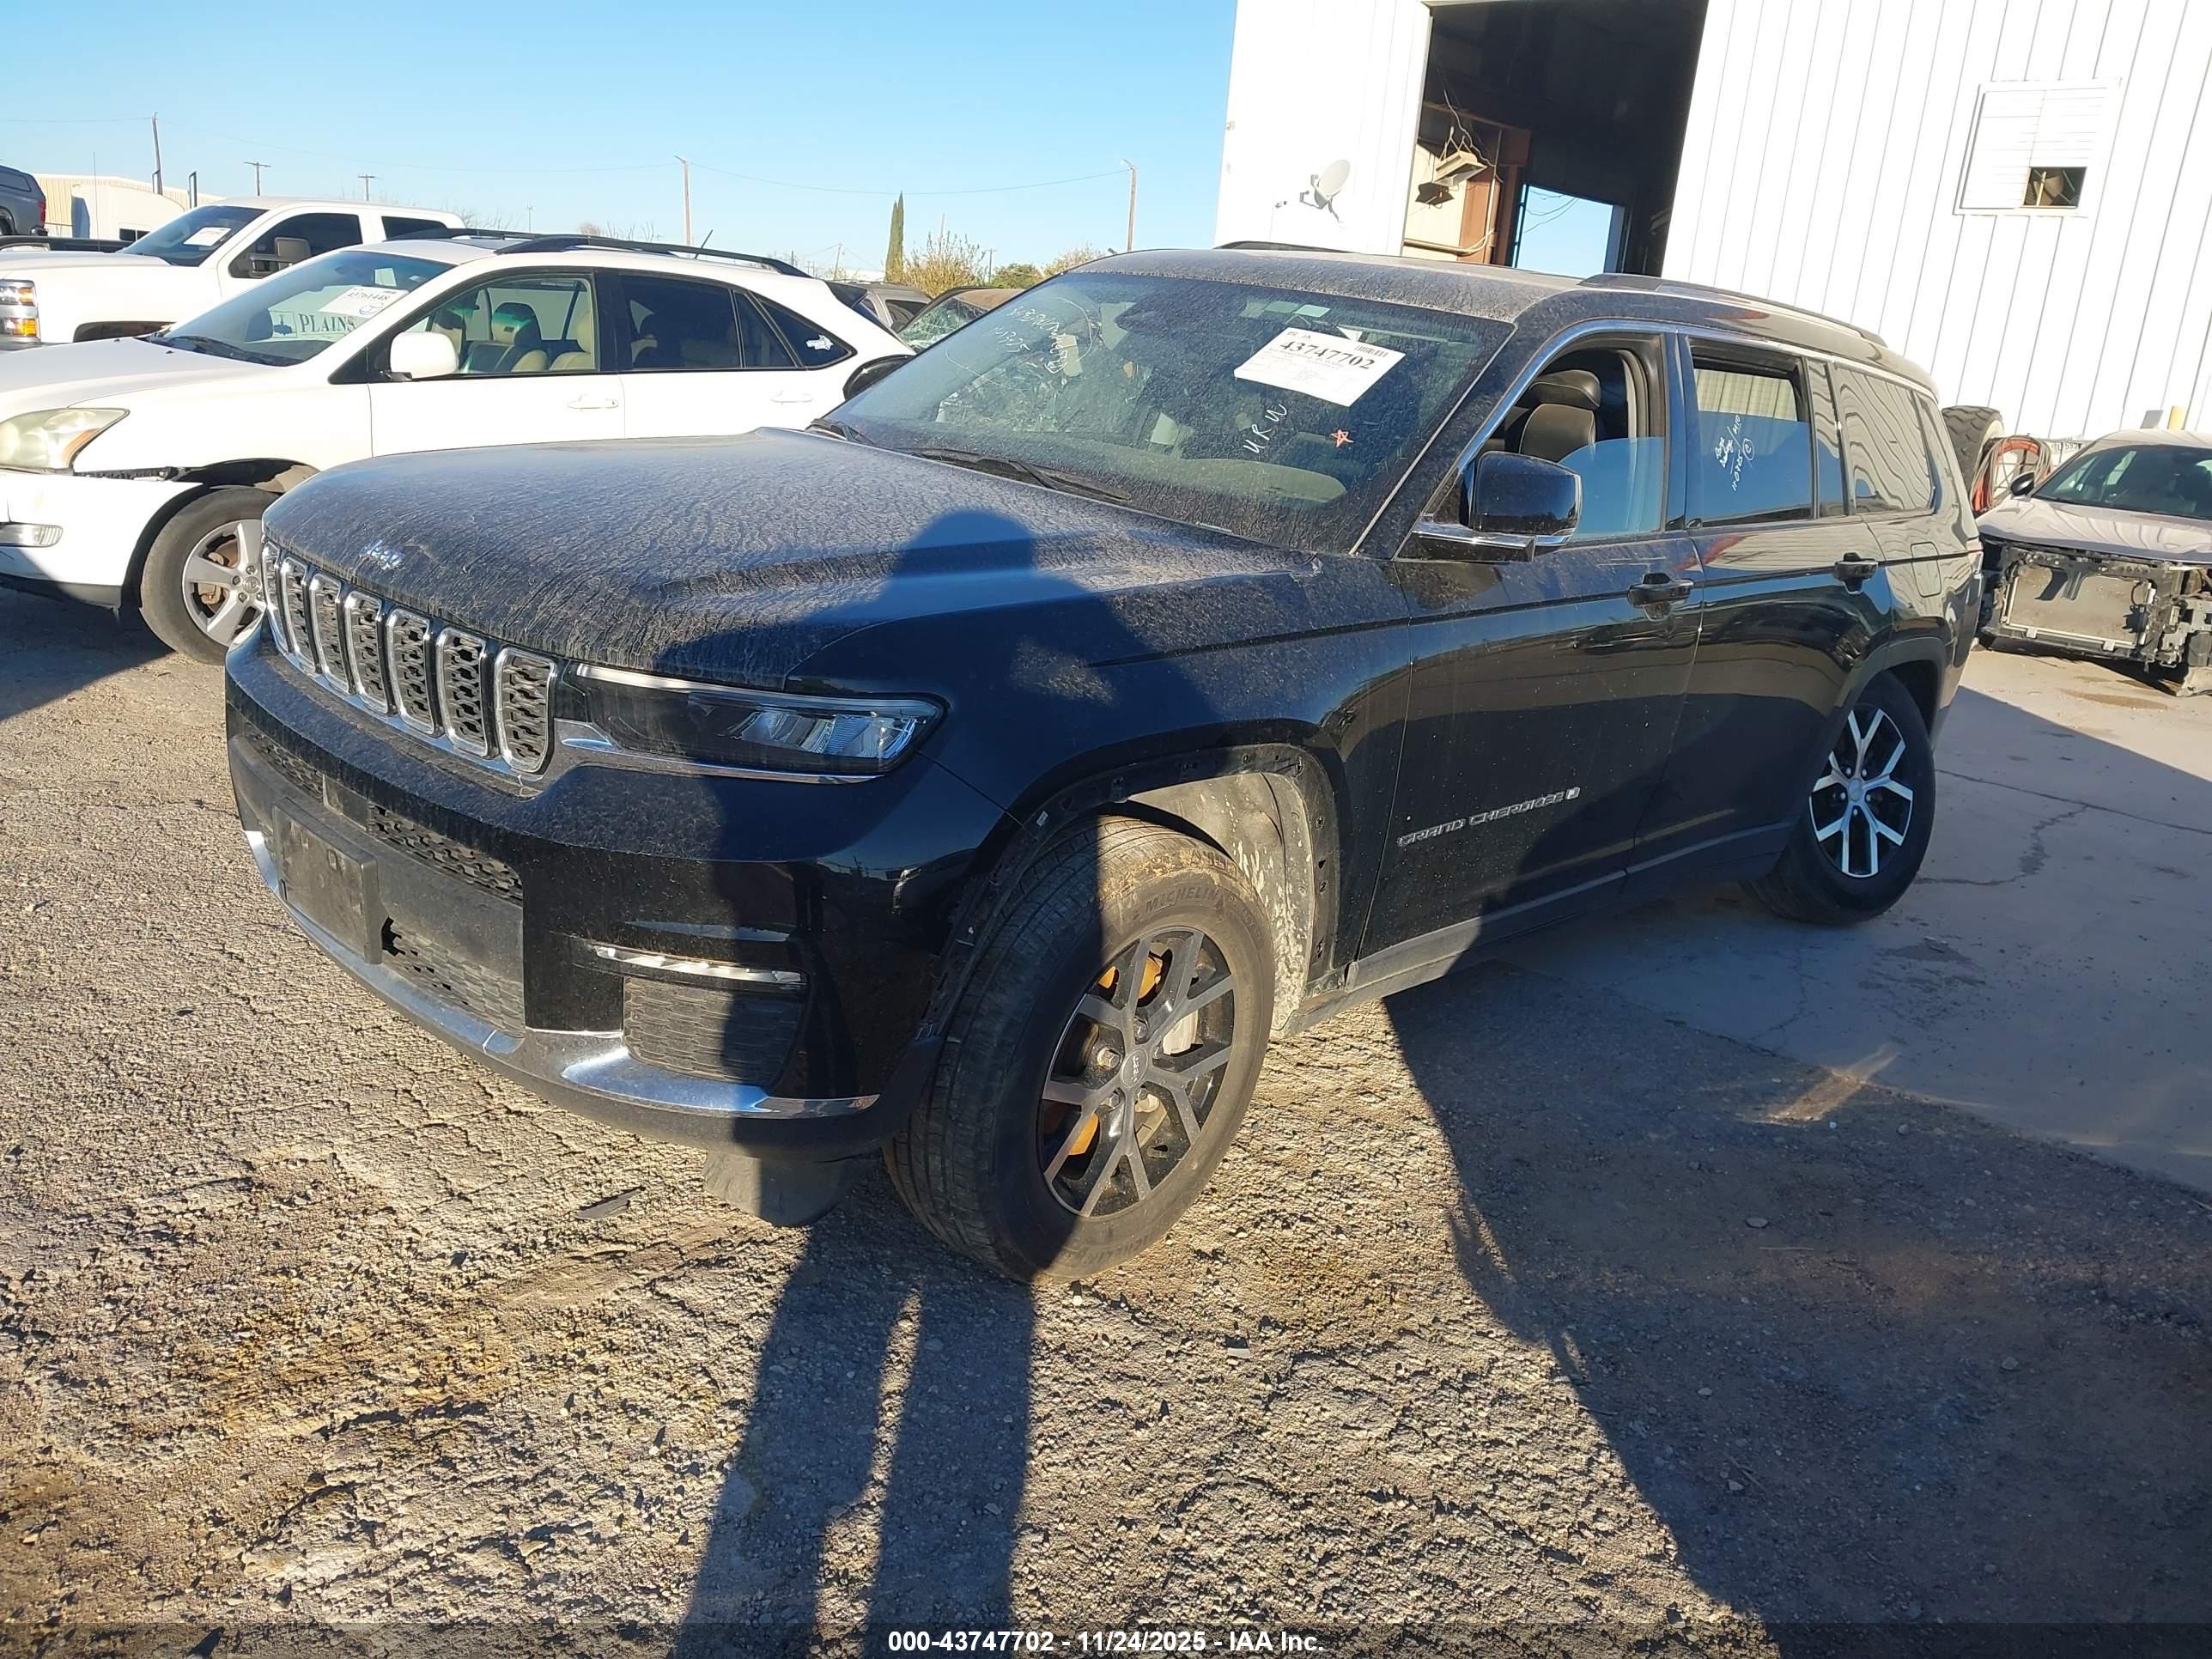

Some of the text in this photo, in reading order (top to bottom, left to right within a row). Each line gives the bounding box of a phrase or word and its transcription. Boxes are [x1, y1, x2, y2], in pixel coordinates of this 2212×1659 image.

[298, 313, 356, 333] PLAINS
[1279, 341, 1375, 369] 43747702
[367, 539, 405, 565] Jeep
[1396, 817, 1466, 847] GRAND
[1469, 791, 1565, 826] CHEROKEE
